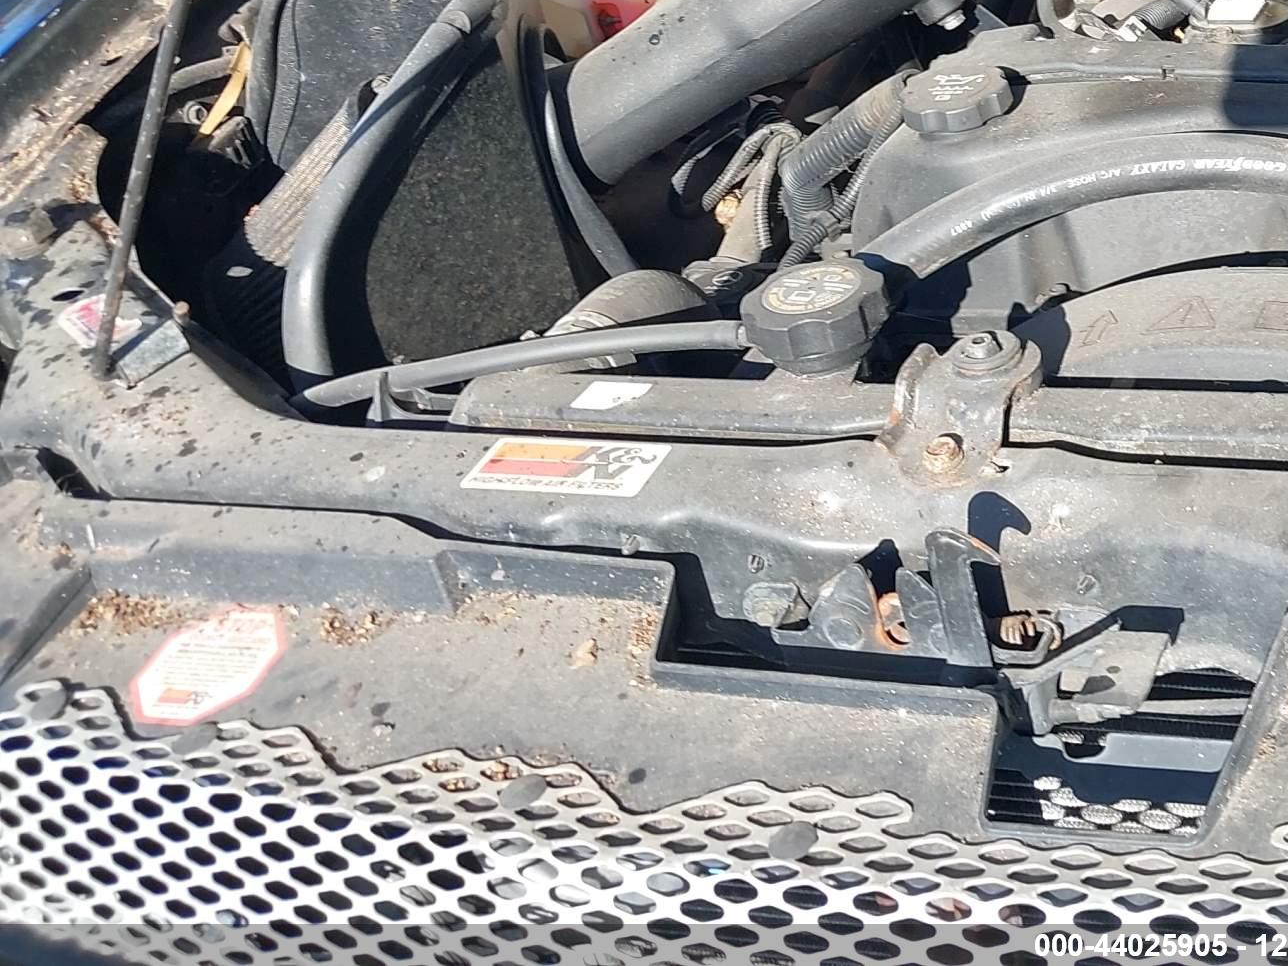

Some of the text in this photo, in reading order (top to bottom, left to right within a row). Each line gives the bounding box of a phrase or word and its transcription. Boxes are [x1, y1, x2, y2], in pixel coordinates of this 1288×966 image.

[1130, 159, 1186, 176] GALAXY
[1193, 156, 1287, 172] GOODYEAR
[1100, 168, 1121, 180] A/C
[566, 445, 657, 480] K&N
